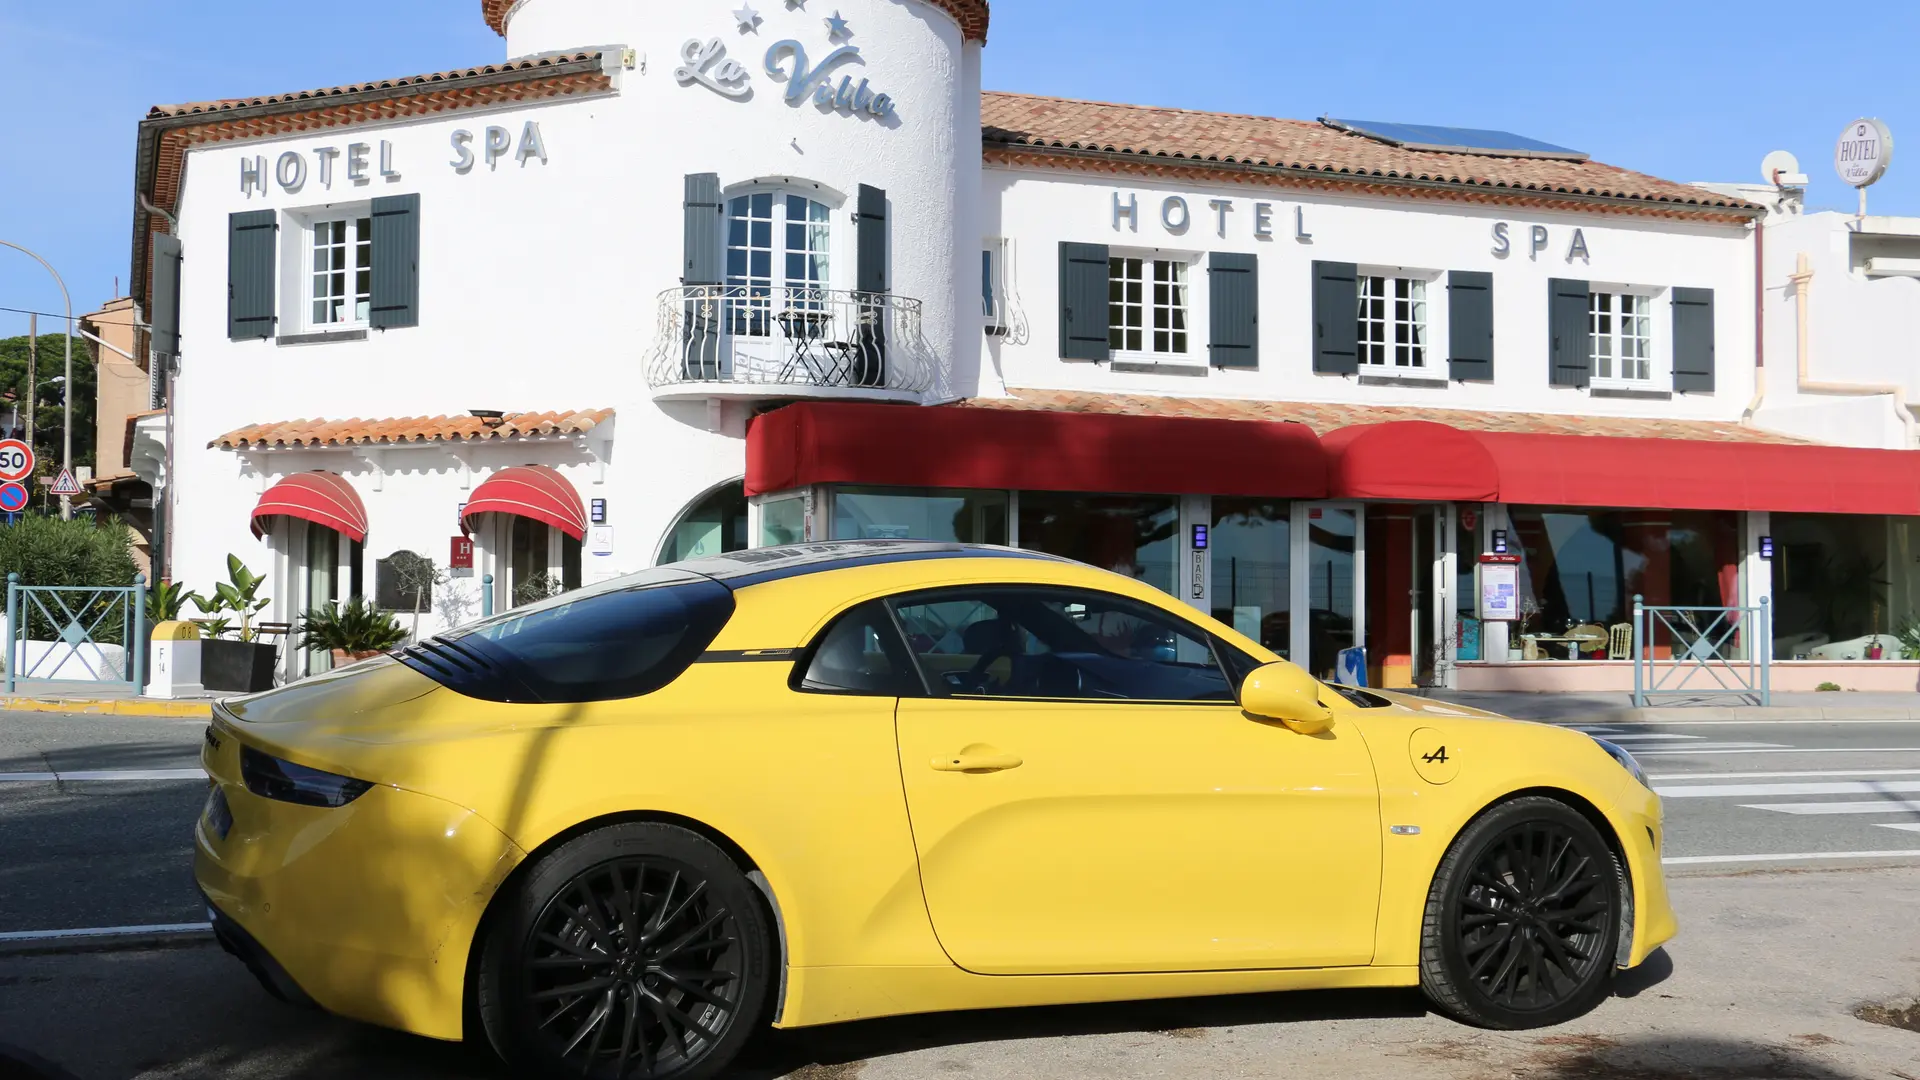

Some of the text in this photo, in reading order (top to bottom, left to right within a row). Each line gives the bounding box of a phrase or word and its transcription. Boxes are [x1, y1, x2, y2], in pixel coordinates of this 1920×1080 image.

[673, 36, 896, 116] La Villa
[240, 120, 548, 195] HOTEL SPA
[1840, 139, 1877, 161] HOTEL
[1845, 168, 1869, 177] Villa
[1111, 191, 1590, 260] HOTEL SPA
[0, 452, 25, 468] 50
[460, 542, 471, 554] H
